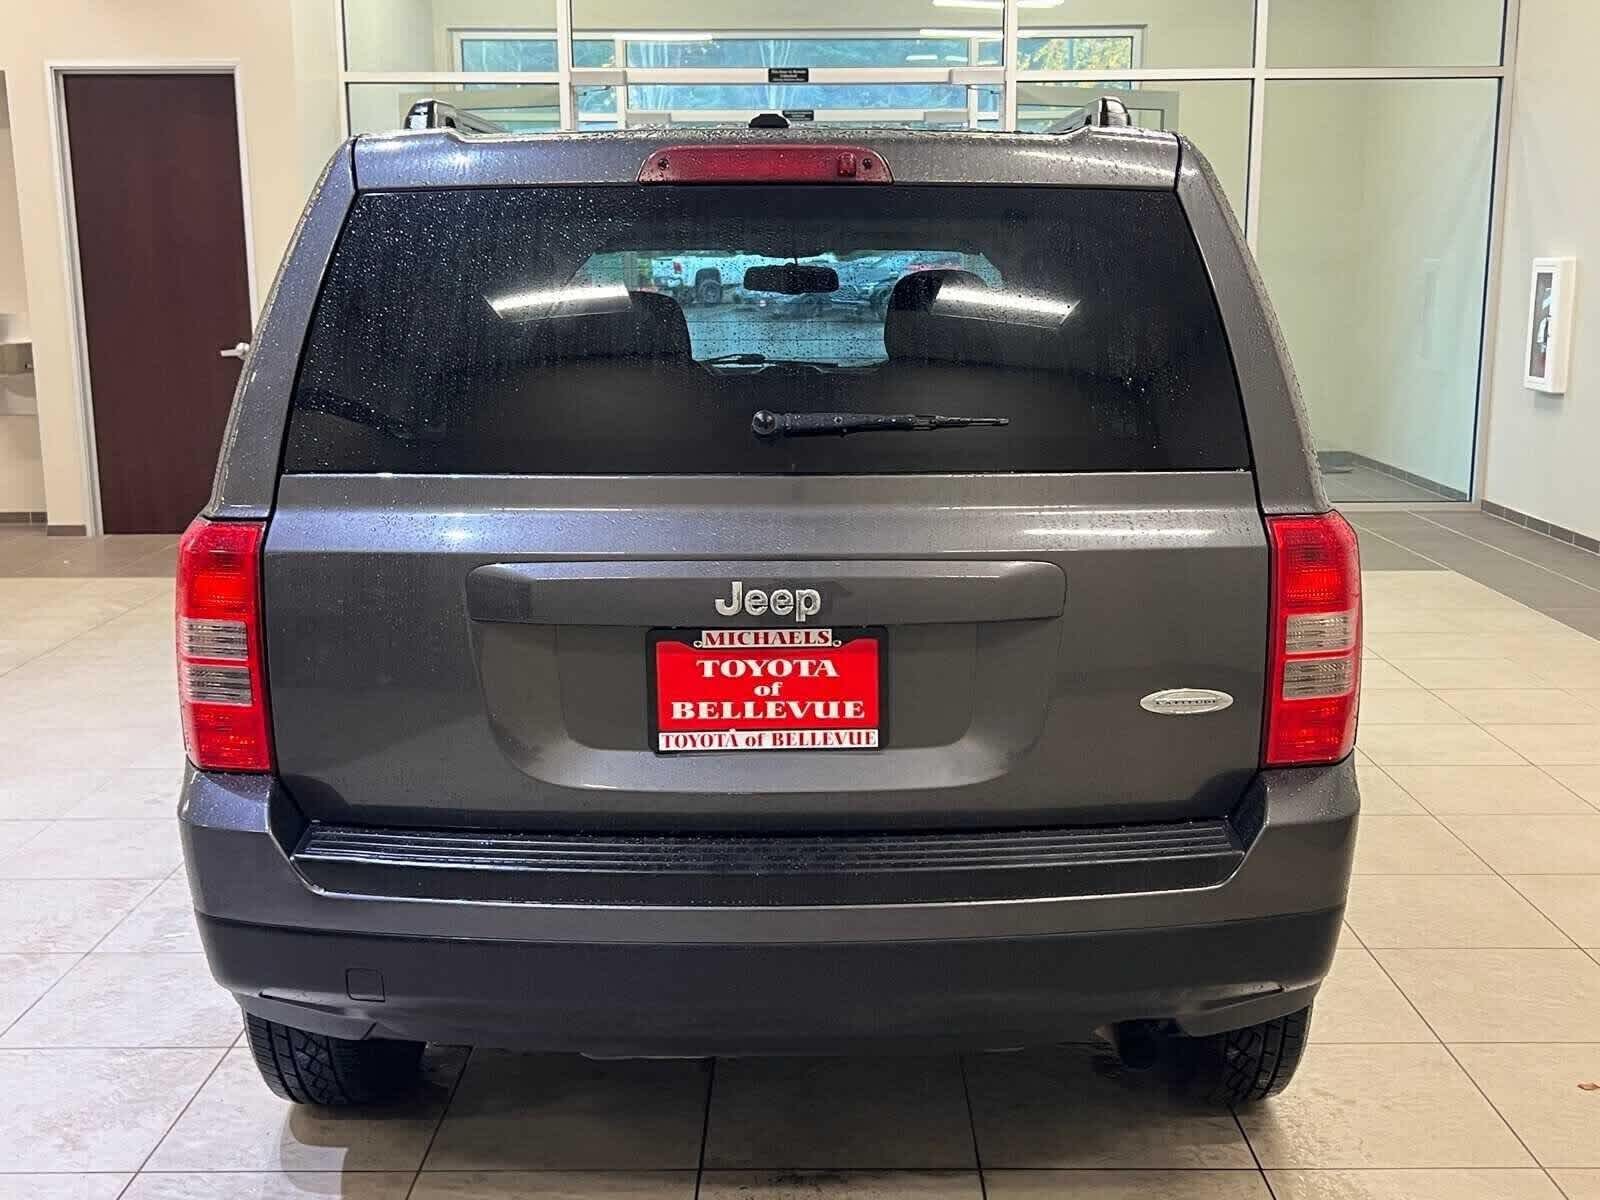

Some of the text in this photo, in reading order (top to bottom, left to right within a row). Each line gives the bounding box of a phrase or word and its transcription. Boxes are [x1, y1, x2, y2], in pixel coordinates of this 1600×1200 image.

[714, 581, 821, 622] Jeep
[704, 631, 830, 646] MICHAELS
[696, 659, 840, 678] TOYOTA
[753, 682, 783, 697] of
[671, 700, 865, 720] BELLEVUE
[661, 731, 876, 748] TOYOTA of BELLEVUE
